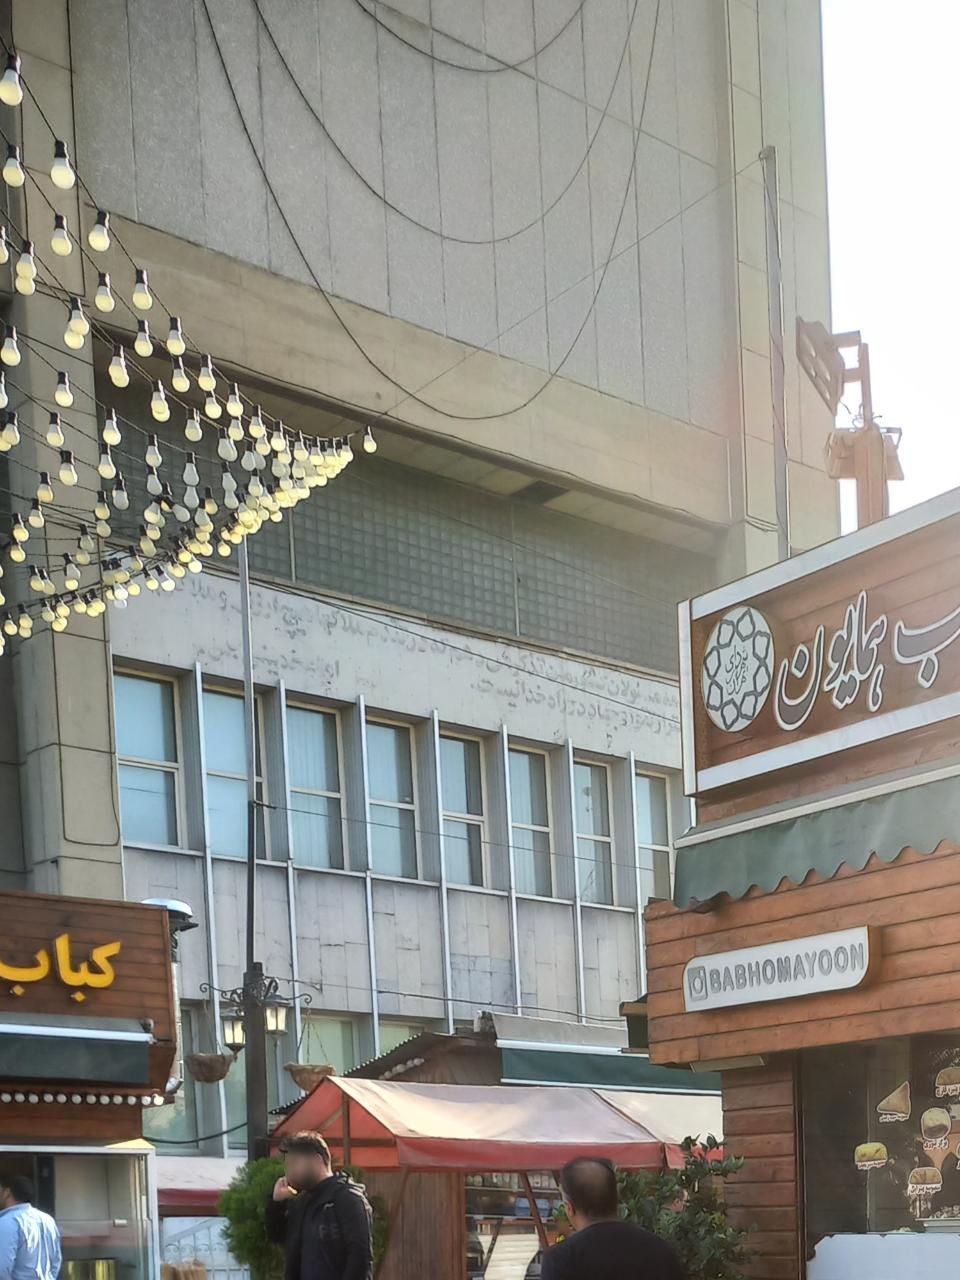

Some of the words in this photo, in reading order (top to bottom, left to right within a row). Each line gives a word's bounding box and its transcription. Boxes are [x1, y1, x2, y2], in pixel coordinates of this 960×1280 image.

[774, 590, 889, 731] همایون
[0, 933, 121, 1002] کباب
[709, 943, 865, 993] BABHOMAYOON
